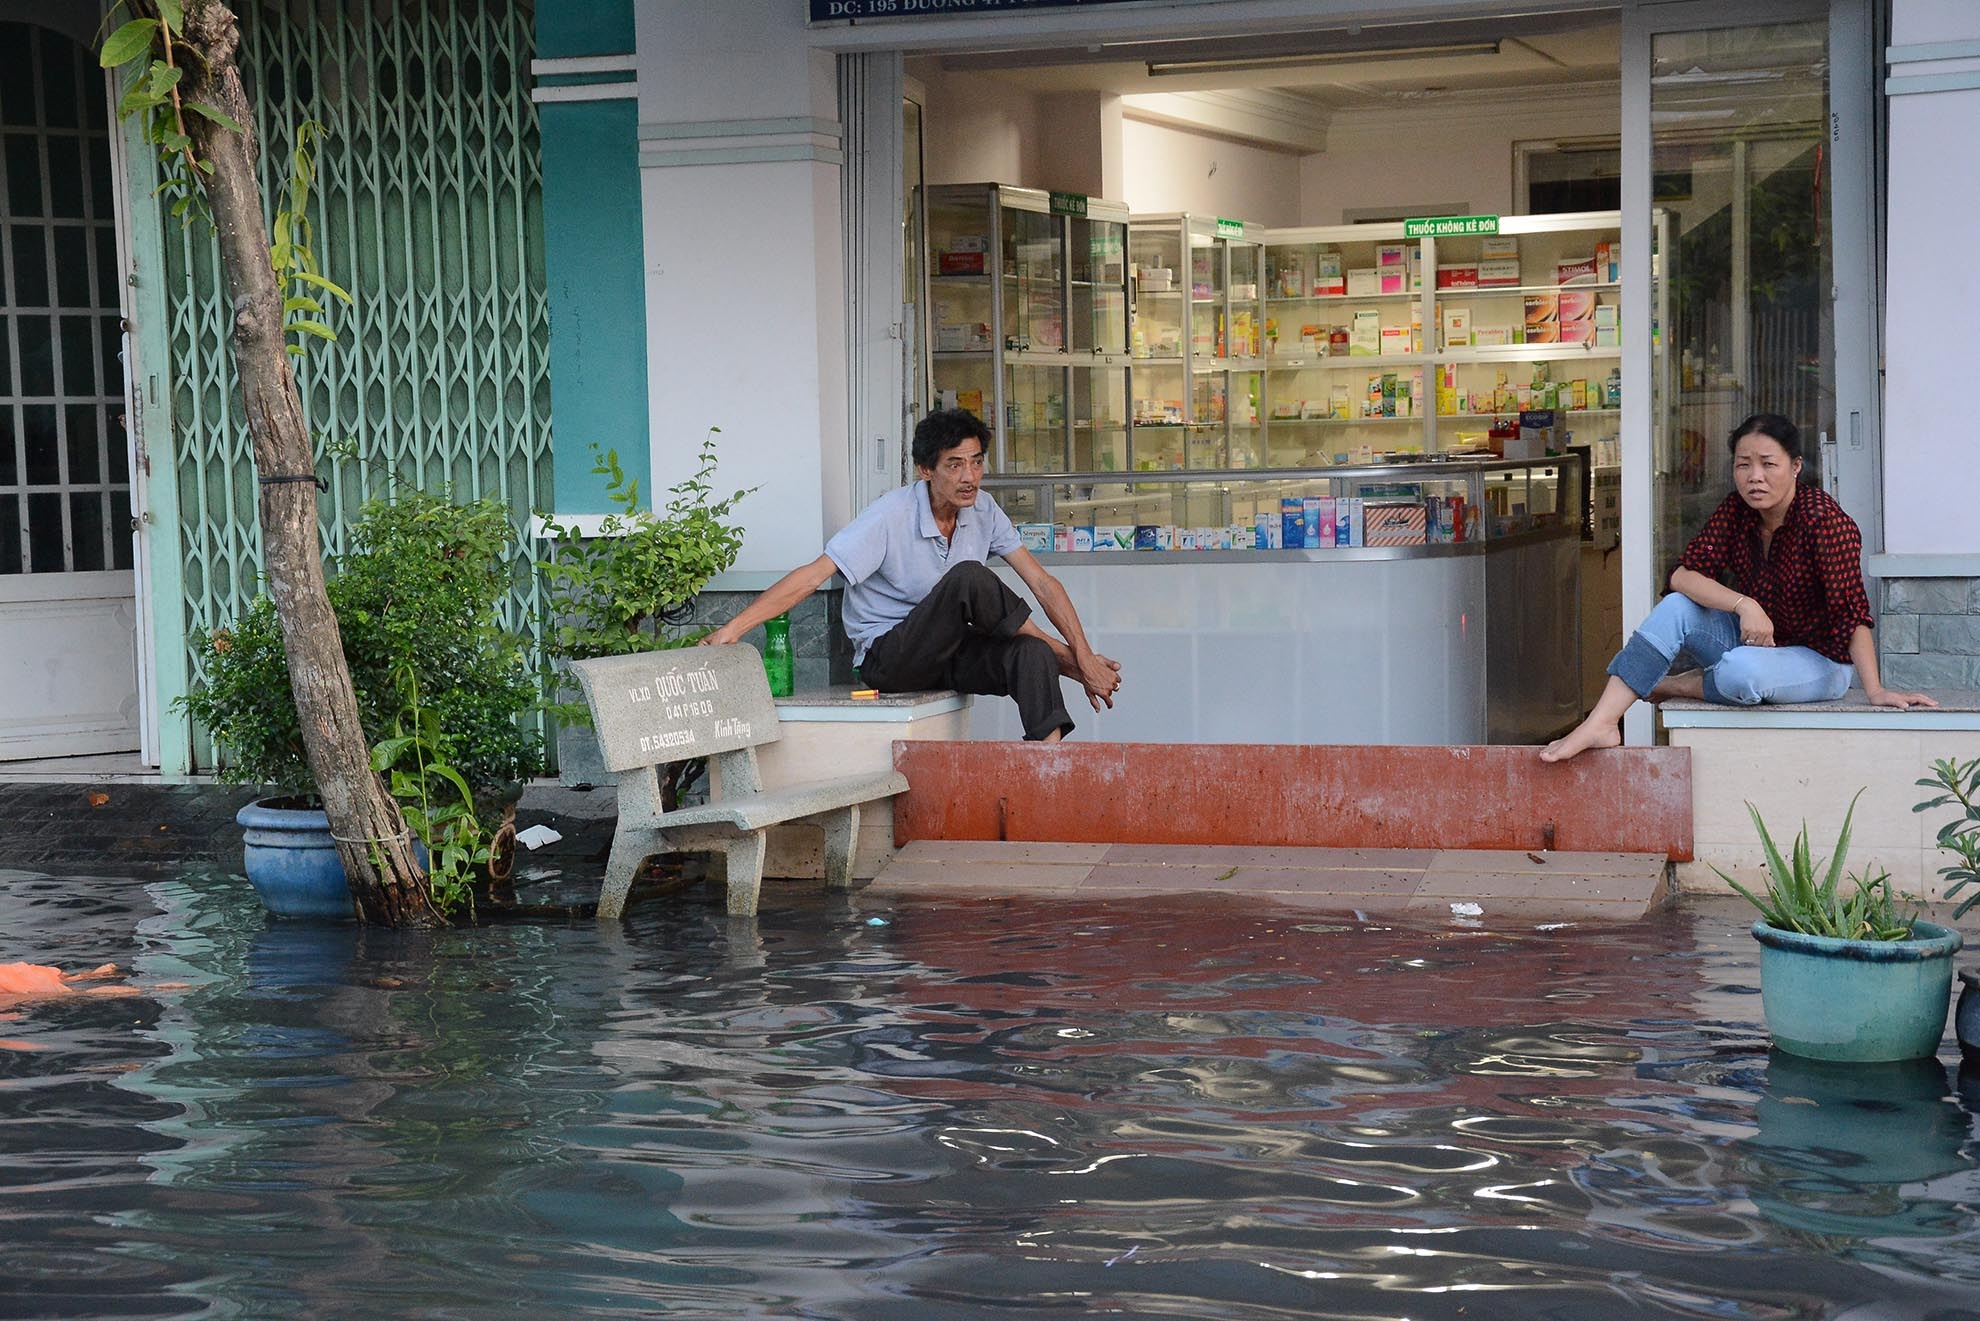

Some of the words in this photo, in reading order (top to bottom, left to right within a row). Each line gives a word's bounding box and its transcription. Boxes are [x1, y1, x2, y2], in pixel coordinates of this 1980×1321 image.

[868, 0, 897, 12] 195
[1408, 219, 1435, 235] THUỐC
[1436, 219, 1465, 234] KHÔNG
[1465, 219, 1477, 232] KÊ
[1478, 218, 1496, 232] ĐƠN
[655, 666, 686, 703] QUỐC
[686, 661, 719, 693] TUẤN
[673, 704, 683, 719] 41
[682, 703, 689, 718] P
[689, 702, 700, 716] 16
